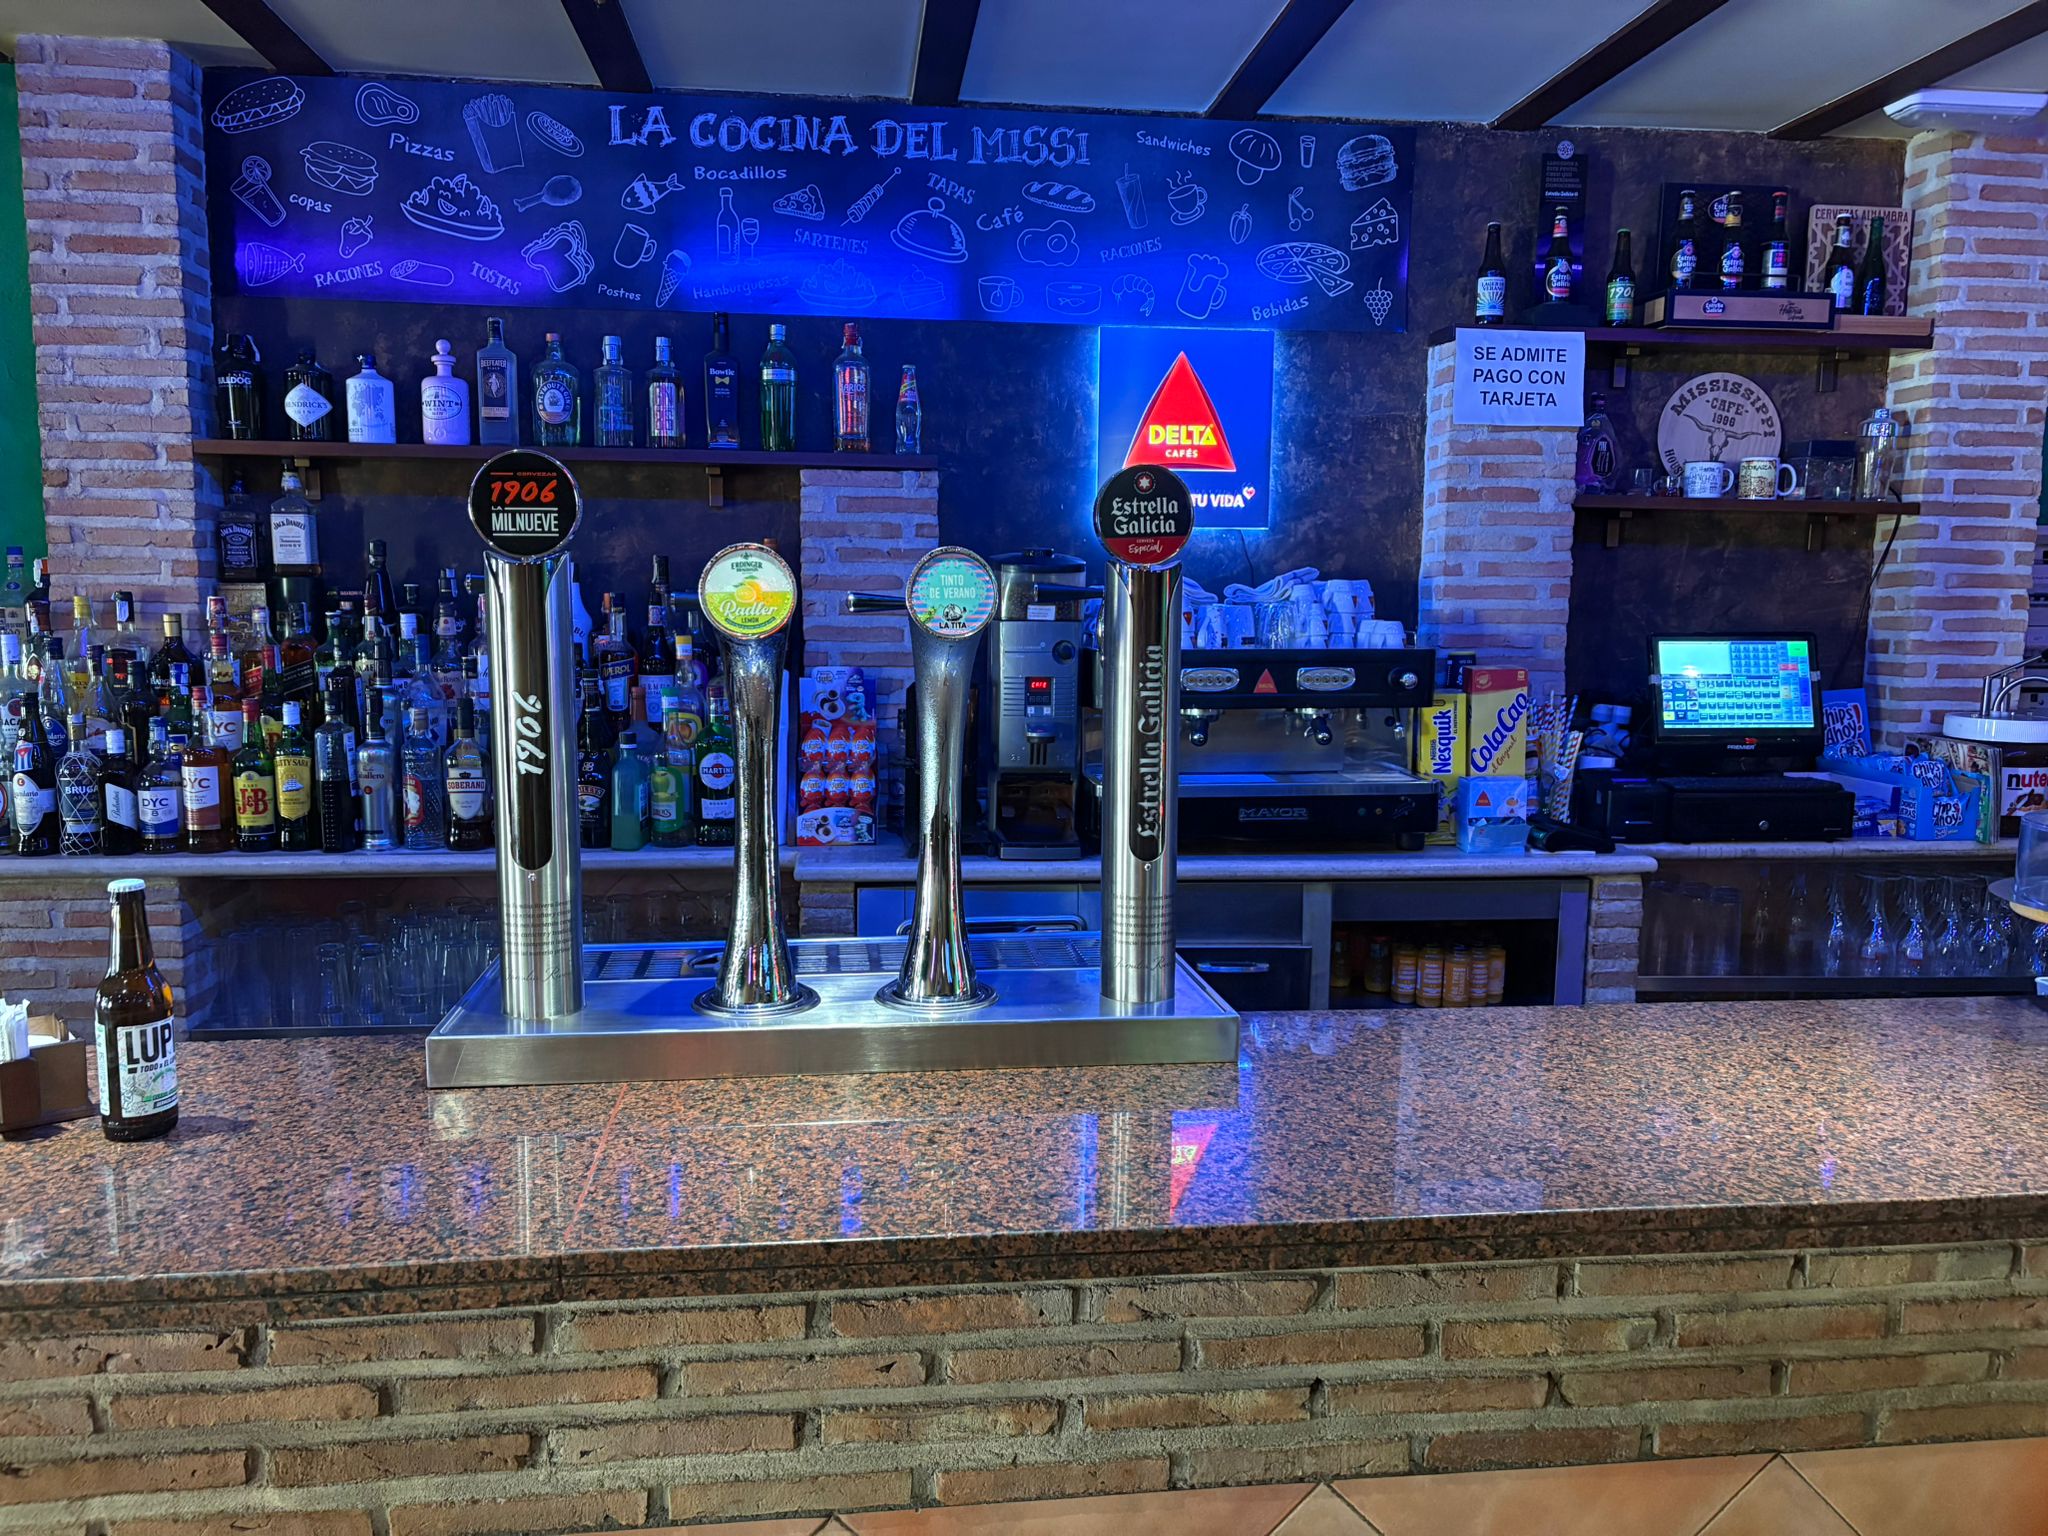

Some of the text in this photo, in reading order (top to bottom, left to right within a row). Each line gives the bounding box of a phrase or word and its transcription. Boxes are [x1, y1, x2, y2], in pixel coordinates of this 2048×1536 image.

[608, 105, 1092, 167] LA COCINA DEL MISSI
[1136, 130, 1212, 157] Sandwiches
[389, 131, 456, 163] Pizzas
[694, 166, 788, 179] Bocadillos
[926, 172, 976, 205] TAPAS
[289, 194, 333, 214] copas
[976, 205, 1024, 231] Café
[794, 228, 869, 254] SARTENES
[1100, 237, 1163, 263] RACIONES
[314, 261, 384, 288] RACIONES
[470, 261, 522, 296] TOSTAS
[598, 284, 642, 302] Postres
[692, 276, 790, 299] Hamburguesas
[1251, 295, 1310, 321] Bebidas
[1474, 346, 1567, 363] SE ADMITE
[1473, 368, 1566, 385] PAGO CON
[424, 400, 454, 408] WINT
[1480, 391, 1557, 406] TARJETA
[1670, 379, 1776, 438] MISSISSIPPI
[1148, 424, 1217, 445] DELTA
[1165, 449, 1198, 459] CAFÉS
[491, 480, 558, 505] 1906
[1210, 494, 1246, 508] VIDA
[1111, 497, 1179, 516] Estrella
[491, 513, 559, 532] MILNUEVE
[1114, 515, 1177, 535] Galicia
[1128, 540, 1163, 555] Especial
[731, 561, 763, 570] ERDINGER
[940, 574, 964, 586] TINTO
[929, 587, 976, 599] DE VERANO
[720, 599, 778, 620] Radler
[938, 621, 967, 629] LA TITA
[1823, 707, 1854, 727] hips
[214, 722, 237, 734] YC
[511, 689, 547, 775] 1906
[1471, 693, 1528, 773] ColaCao
[1137, 645, 1163, 838] Estrella Galicia
[1432, 709, 1457, 774] Nesquik
[702, 766, 734, 774] MARTINI
[1913, 761, 1941, 779] Chips
[2007, 770, 2048, 788] nute
[65, 785, 98, 795] BRUGA
[447, 781, 486, 790] SOBERANO
[578, 785, 603, 796] AILEYS
[142, 797, 169, 808] DYC
[238, 788, 269, 816] J&B
[1239, 807, 1309, 817] MAYOR
[1853, 820, 1871, 828] REO
[125, 1022, 176, 1065] LUP
[140, 1063, 158, 1073] TODO
